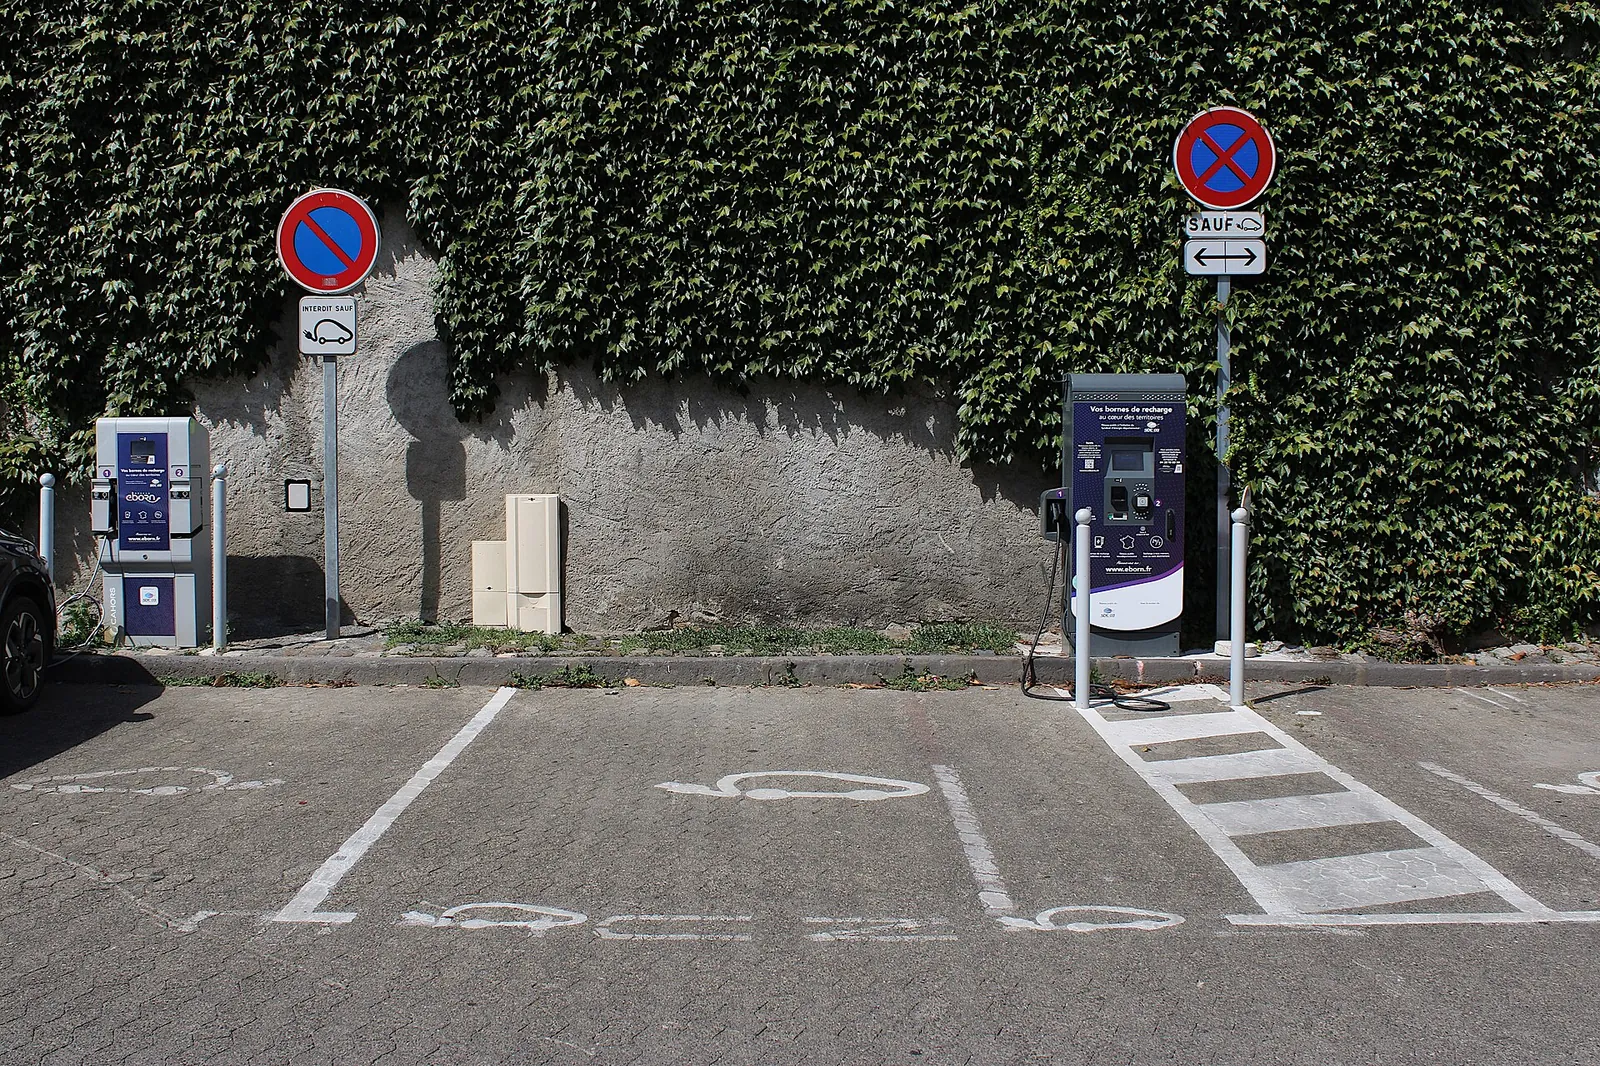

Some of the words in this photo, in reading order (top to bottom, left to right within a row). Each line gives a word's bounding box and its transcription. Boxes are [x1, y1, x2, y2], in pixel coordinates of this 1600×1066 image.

[1189, 217, 1233, 231] SAUF
[1090, 405, 1104, 413] Vos
[1105, 405, 1130, 413] bornes
[1131, 405, 1141, 413] de
[1142, 405, 1173, 415] recharge
[125, 492, 161, 503] eborn
[109, 587, 117, 625] CAHORS
